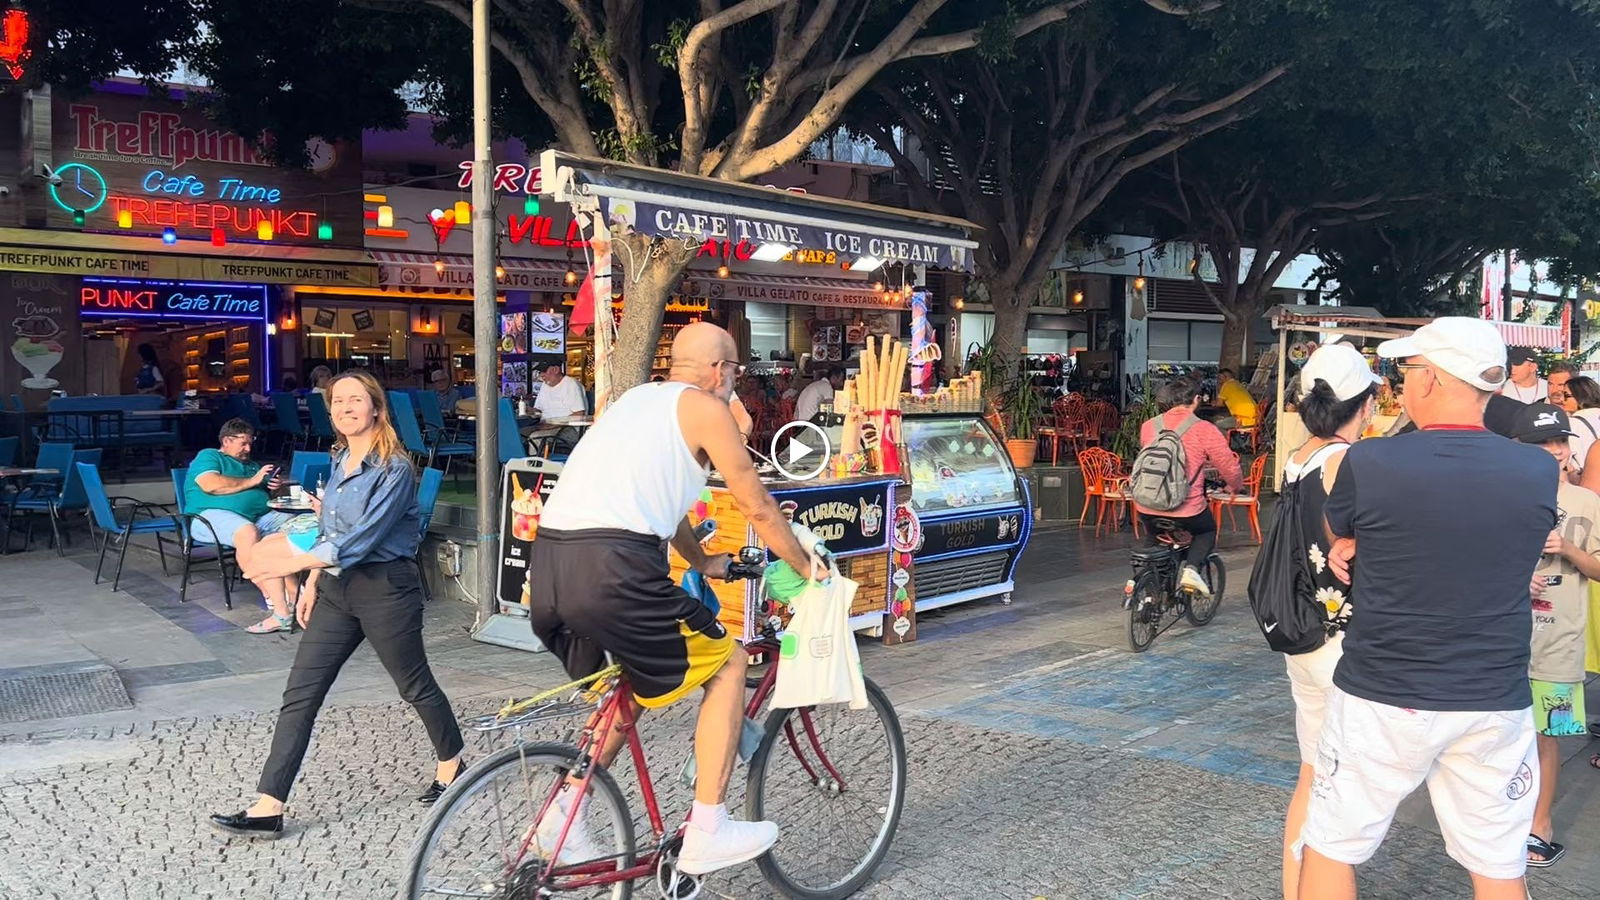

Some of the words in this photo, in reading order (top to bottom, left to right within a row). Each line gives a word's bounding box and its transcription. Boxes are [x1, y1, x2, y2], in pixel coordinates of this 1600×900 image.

[143, 169, 205, 196] Cafe
[218, 178, 281, 204] Time
[508, 213, 592, 248] VILL
[655, 209, 728, 238] CAFE
[737, 219, 803, 245] TIME
[825, 232, 861, 254] ICE
[869, 238, 938, 264] CREAM
[0, 252, 83, 268] TREFFPUNKT
[86, 257, 118, 270] CAFE
[121, 260, 149, 272] TIME
[222, 264, 294, 278] TREFFPUNKT
[295, 268, 322, 280] CAFE
[325, 269, 350, 281] TIME
[533, 276, 559, 288] CAFE
[81, 287, 158, 310] PUNKT
[167, 292, 210, 311] Cafe
[213, 294, 260, 313] Time
[737, 286, 767, 299] VILLA
[770, 288, 809, 301] GELATO
[812, 292, 833, 303] CAFE
[799, 501, 858, 528] TURKISH
[812, 522, 845, 541] GOLD
[940, 517, 985, 536] TURKISH
[945, 534, 976, 549] GOLD
